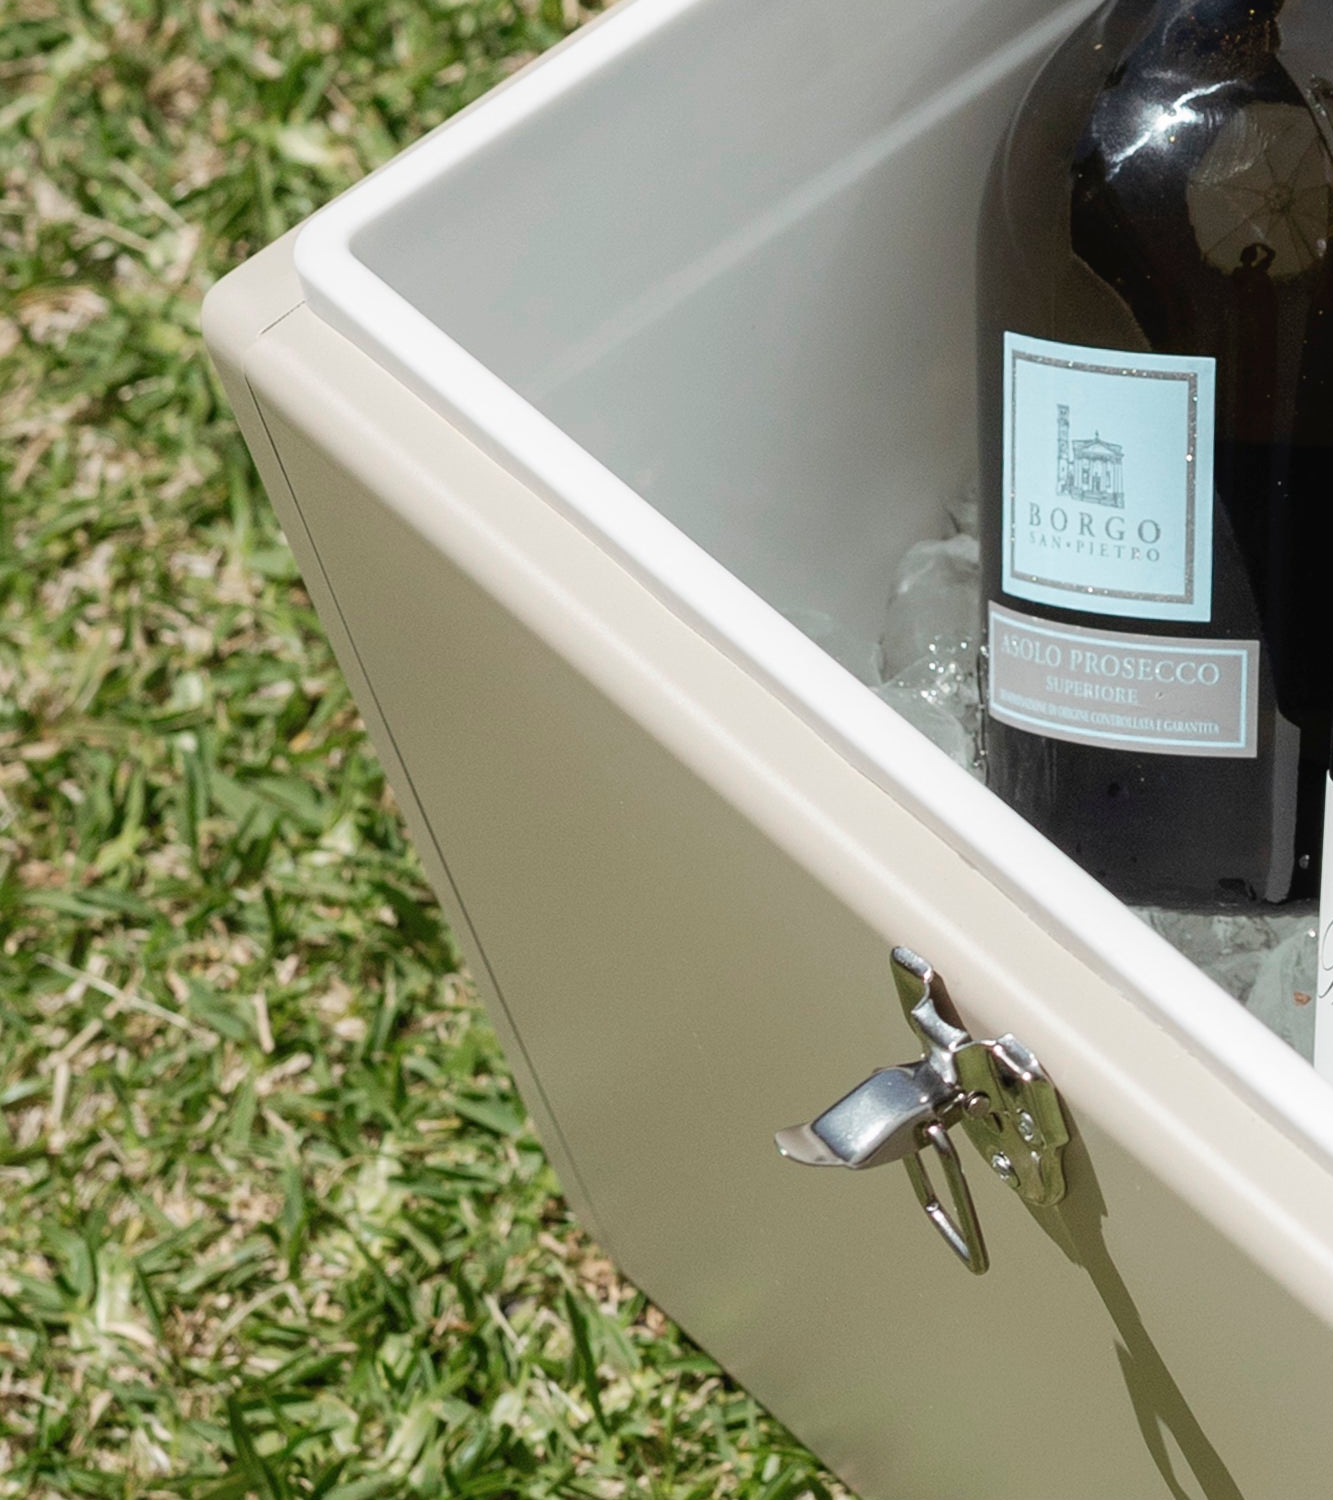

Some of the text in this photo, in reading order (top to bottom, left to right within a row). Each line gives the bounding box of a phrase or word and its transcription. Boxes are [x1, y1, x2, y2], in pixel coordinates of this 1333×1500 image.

[1028, 502, 1161, 544] BORGO
[1001, 634, 1220, 686] ASOLO PROSECCO
[1046, 675, 1138, 704] SUPERIORE
